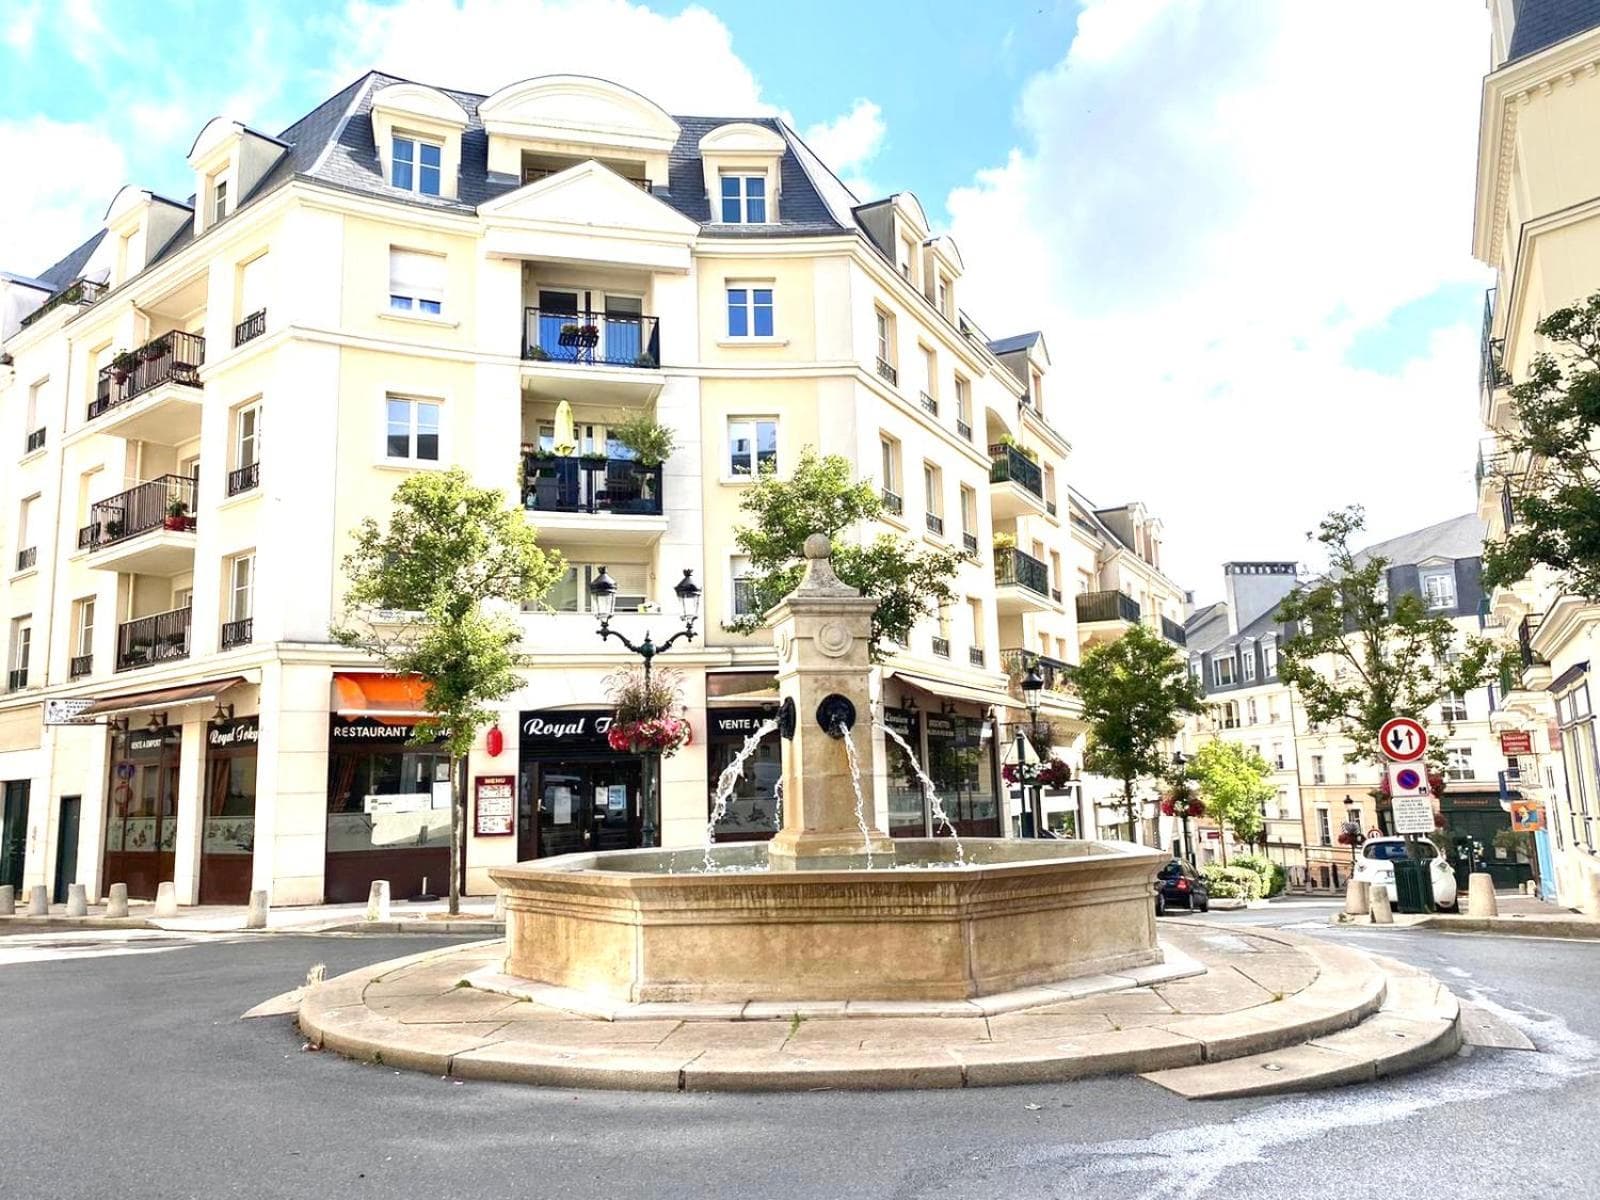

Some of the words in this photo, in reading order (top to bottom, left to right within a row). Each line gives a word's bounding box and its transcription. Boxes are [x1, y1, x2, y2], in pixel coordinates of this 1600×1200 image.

[334, 726, 407, 737] RESTAURANT
[522, 717, 585, 738] Royal
[719, 719, 751, 730] VENTE
[752, 719, 761, 729] A
[210, 727, 236, 746] Royal
